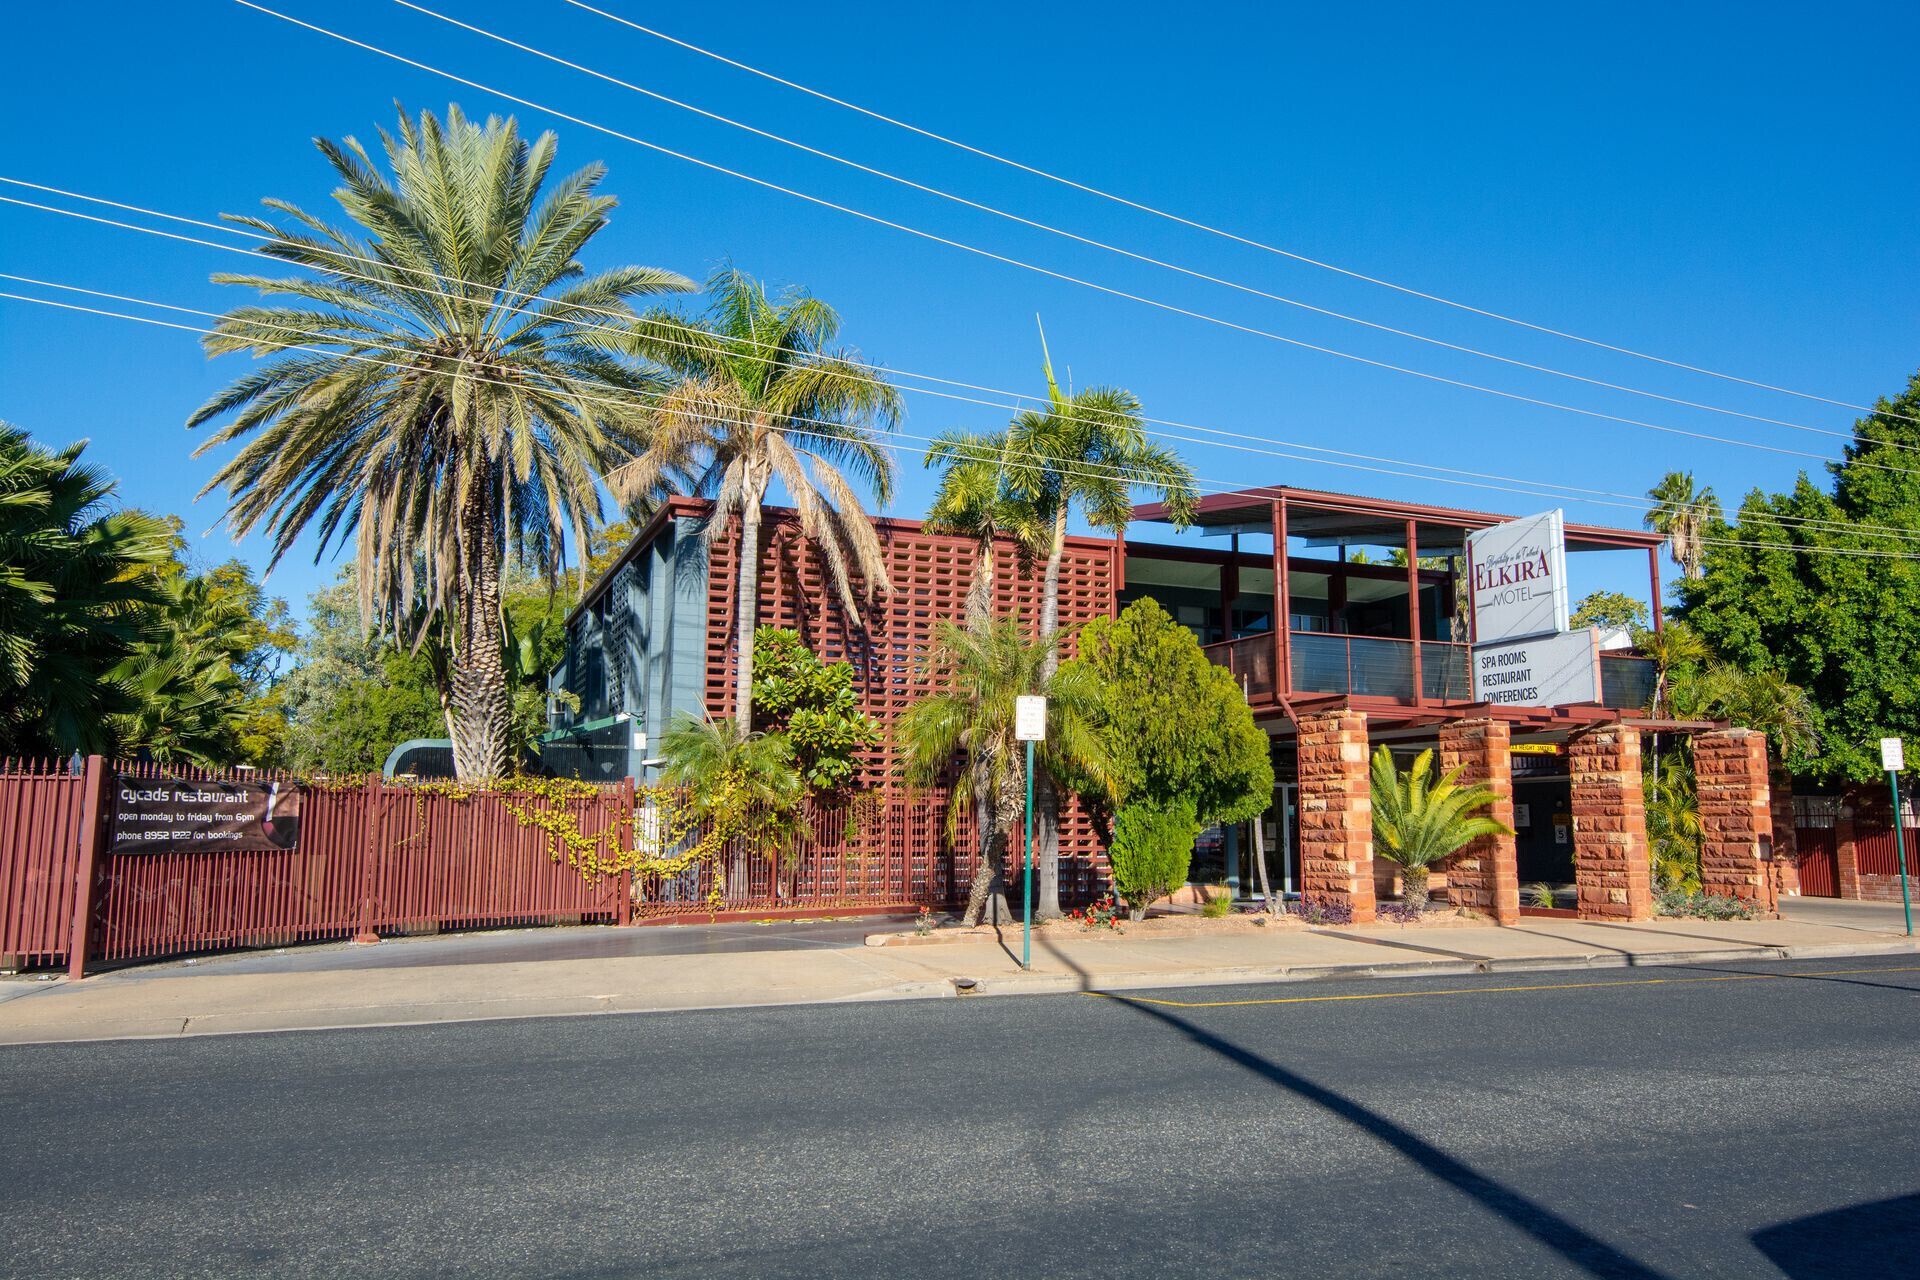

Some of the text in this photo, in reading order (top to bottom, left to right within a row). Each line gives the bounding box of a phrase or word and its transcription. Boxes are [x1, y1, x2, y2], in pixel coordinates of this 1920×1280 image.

[1475, 549, 1550, 591] ELKIRA
[1493, 586, 1533, 607] MOTEL
[1481, 651, 1527, 669] SPA ROOMS
[1482, 669, 1531, 687] RESTAURANT
[1483, 687, 1538, 704] CONFERENCES
[121, 788, 249, 803] cycads restaurant
[118, 812, 255, 823] open monday to friday from 6pm
[116, 831, 243, 842] phone 8952 1222 for bookings
[1558, 831, 1565, 839] 5
